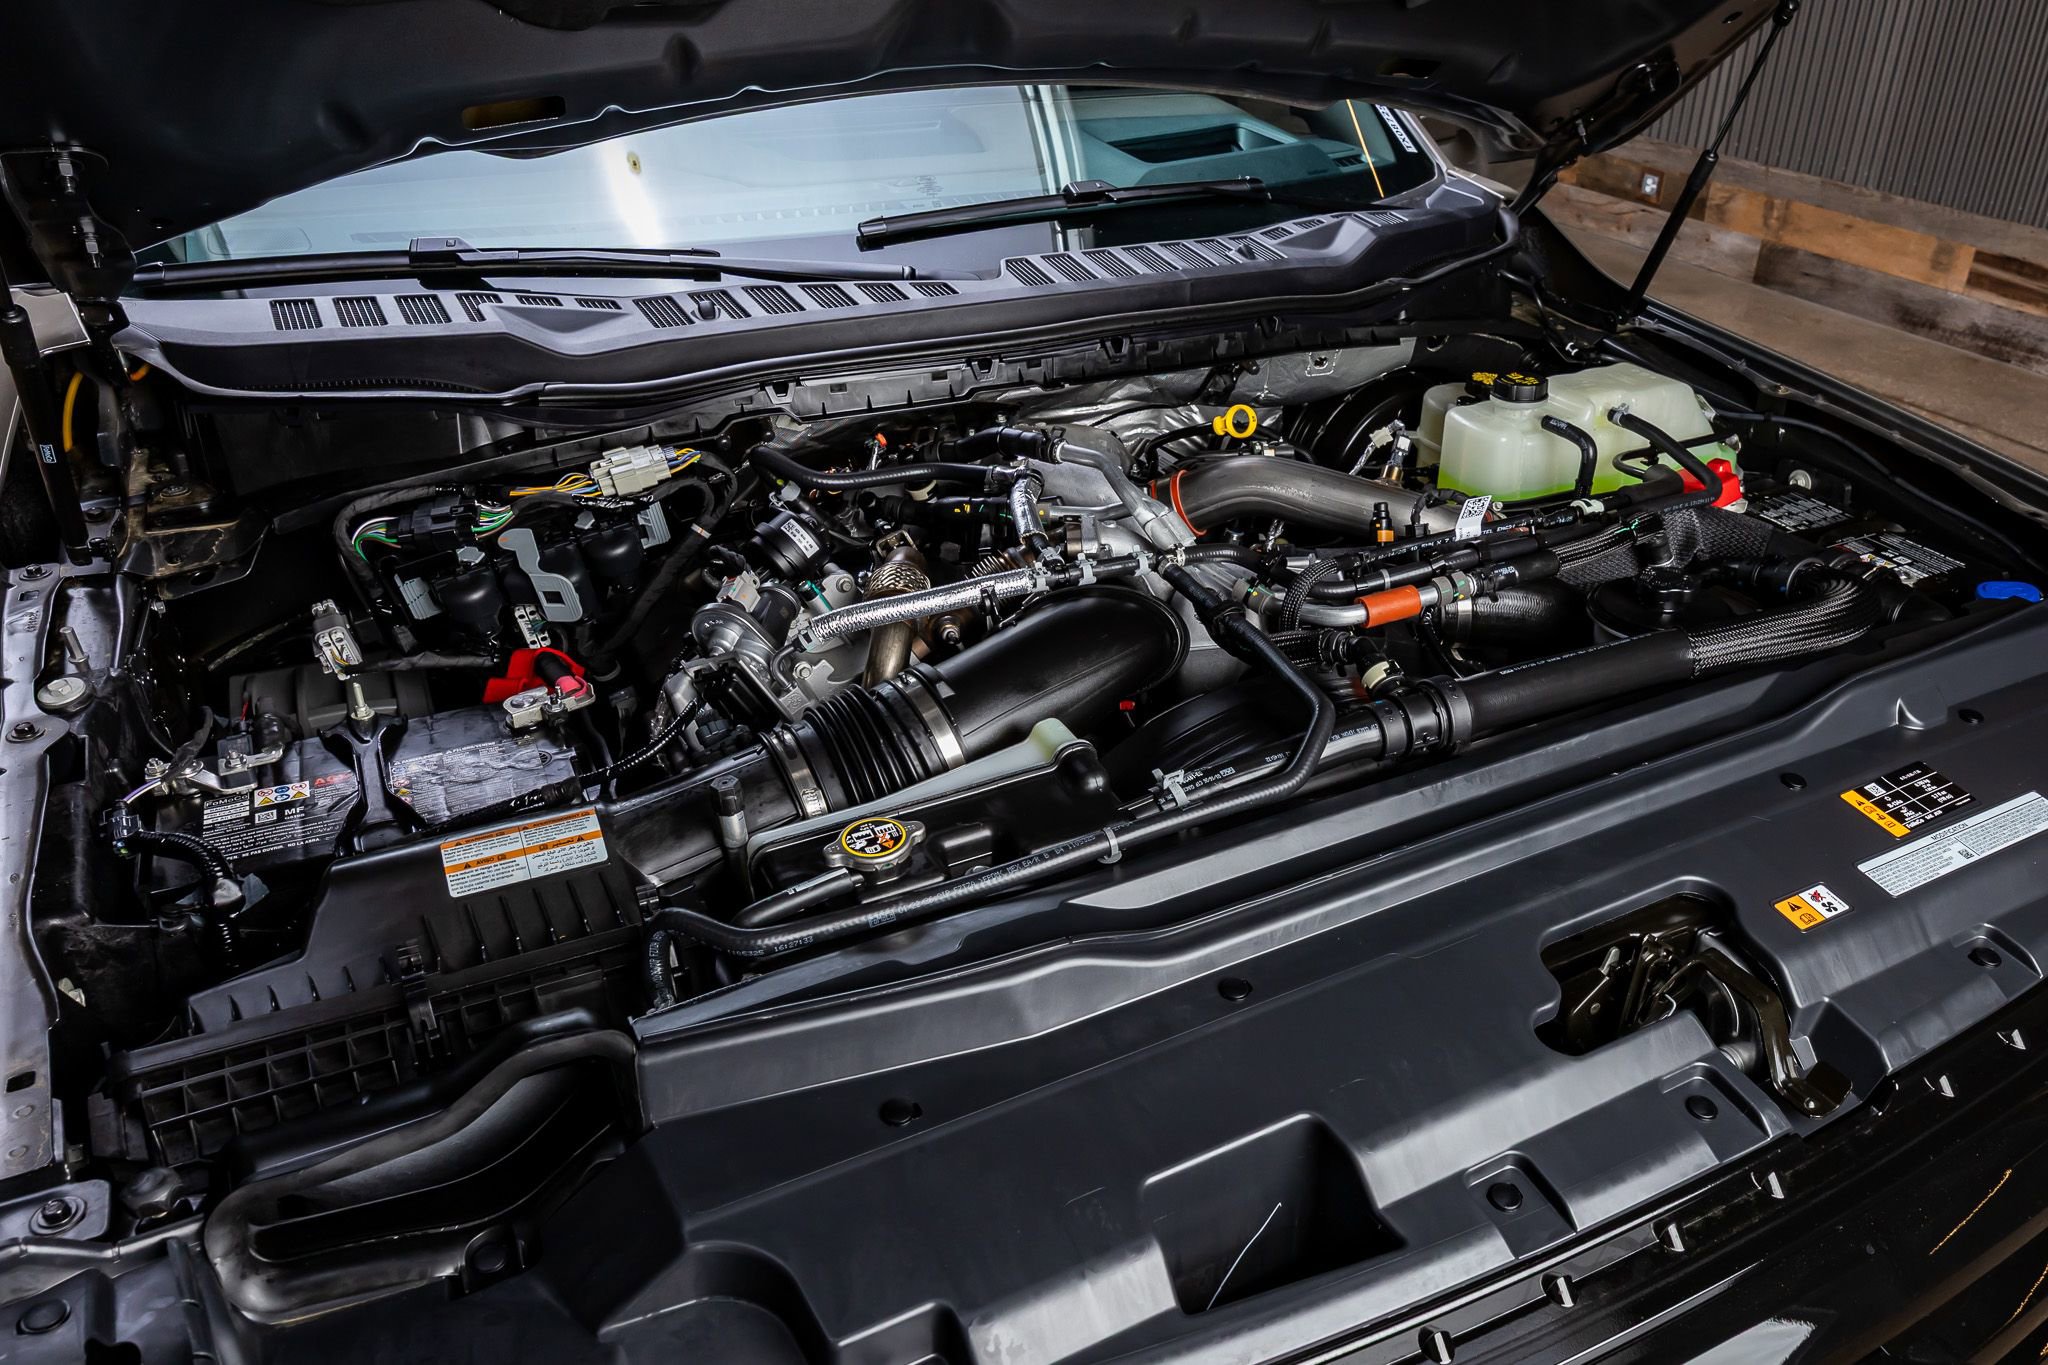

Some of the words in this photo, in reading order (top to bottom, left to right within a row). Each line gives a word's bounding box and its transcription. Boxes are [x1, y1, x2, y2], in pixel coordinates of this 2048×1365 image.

[205, 794, 248, 807] FoMoCo
[285, 806, 304, 816] MF
[1930, 822, 1968, 840] MODIFICATION
[773, 935, 814, 951] 16:27:33
